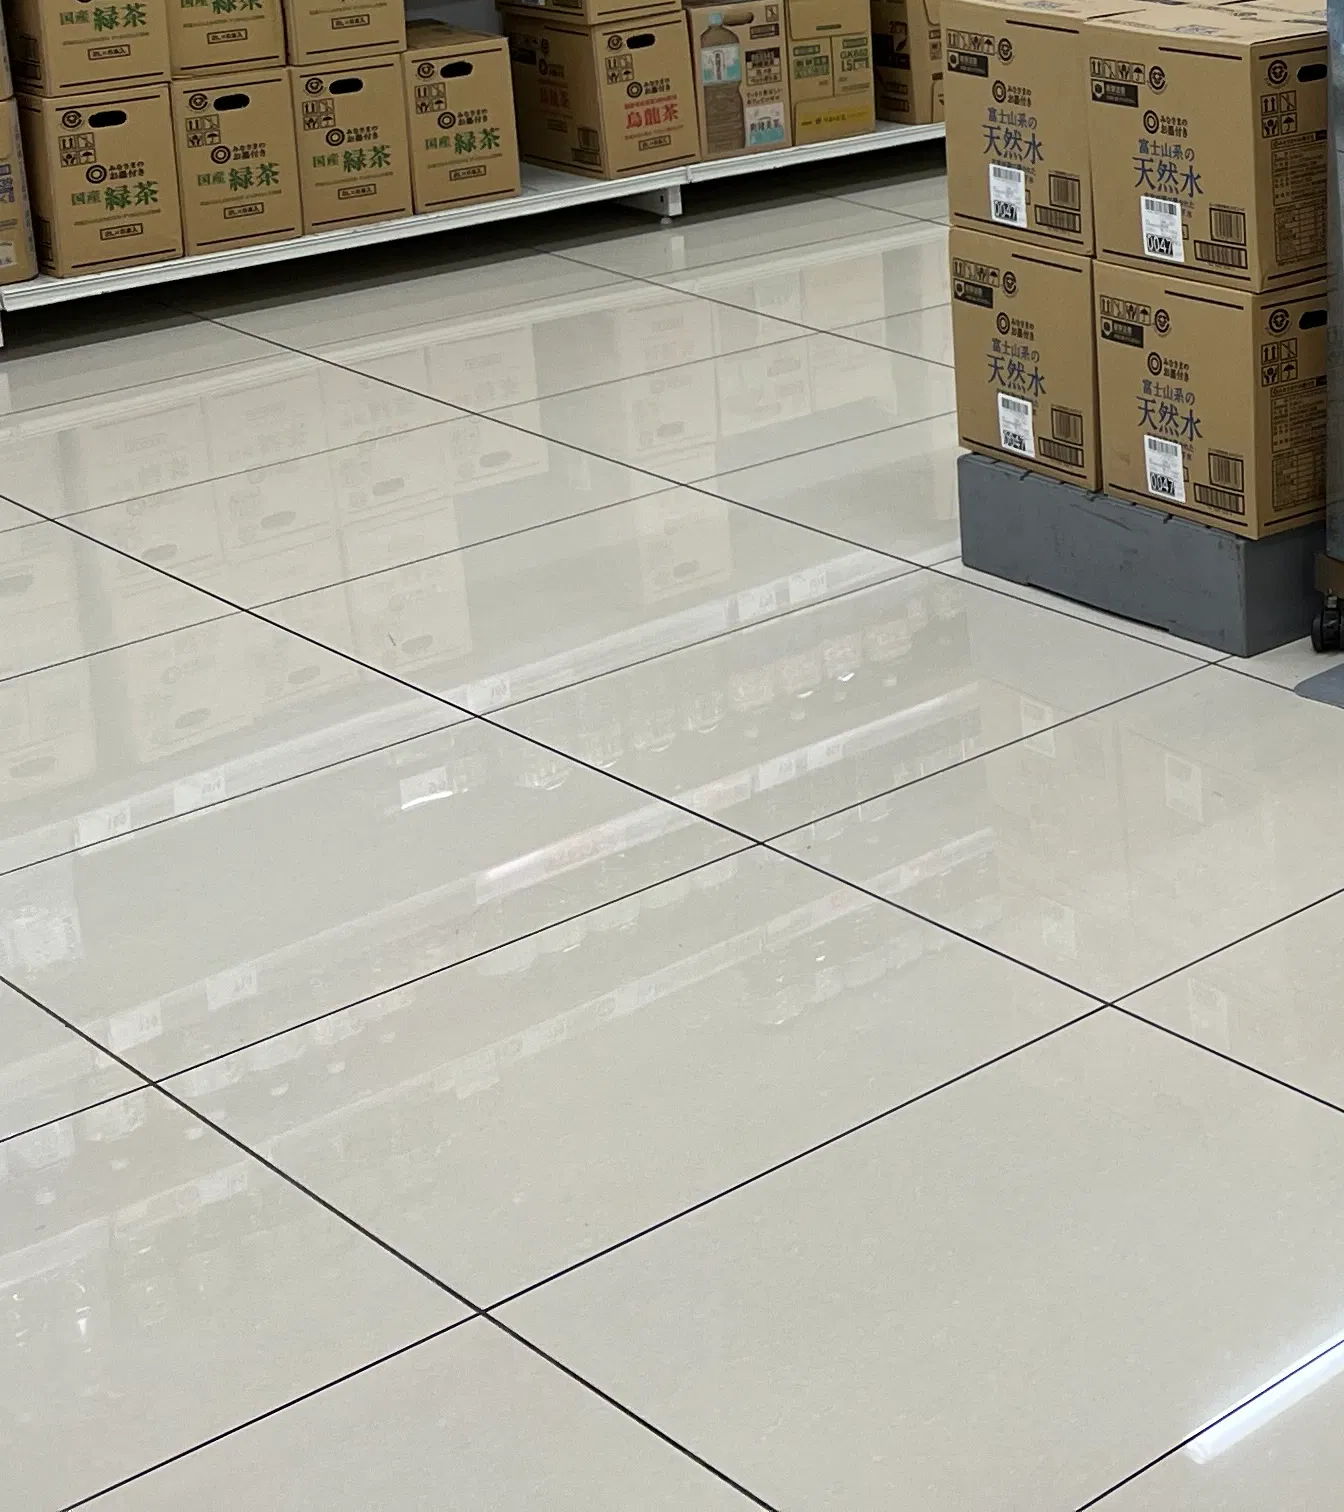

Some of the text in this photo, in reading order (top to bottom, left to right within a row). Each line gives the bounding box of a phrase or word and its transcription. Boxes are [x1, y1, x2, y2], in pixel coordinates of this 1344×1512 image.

[982, 124, 1044, 164] 天然水
[1132, 157, 1204, 198] 天然水
[986, 354, 1047, 397] 天然水
[1136, 396, 1203, 442] 天然水
